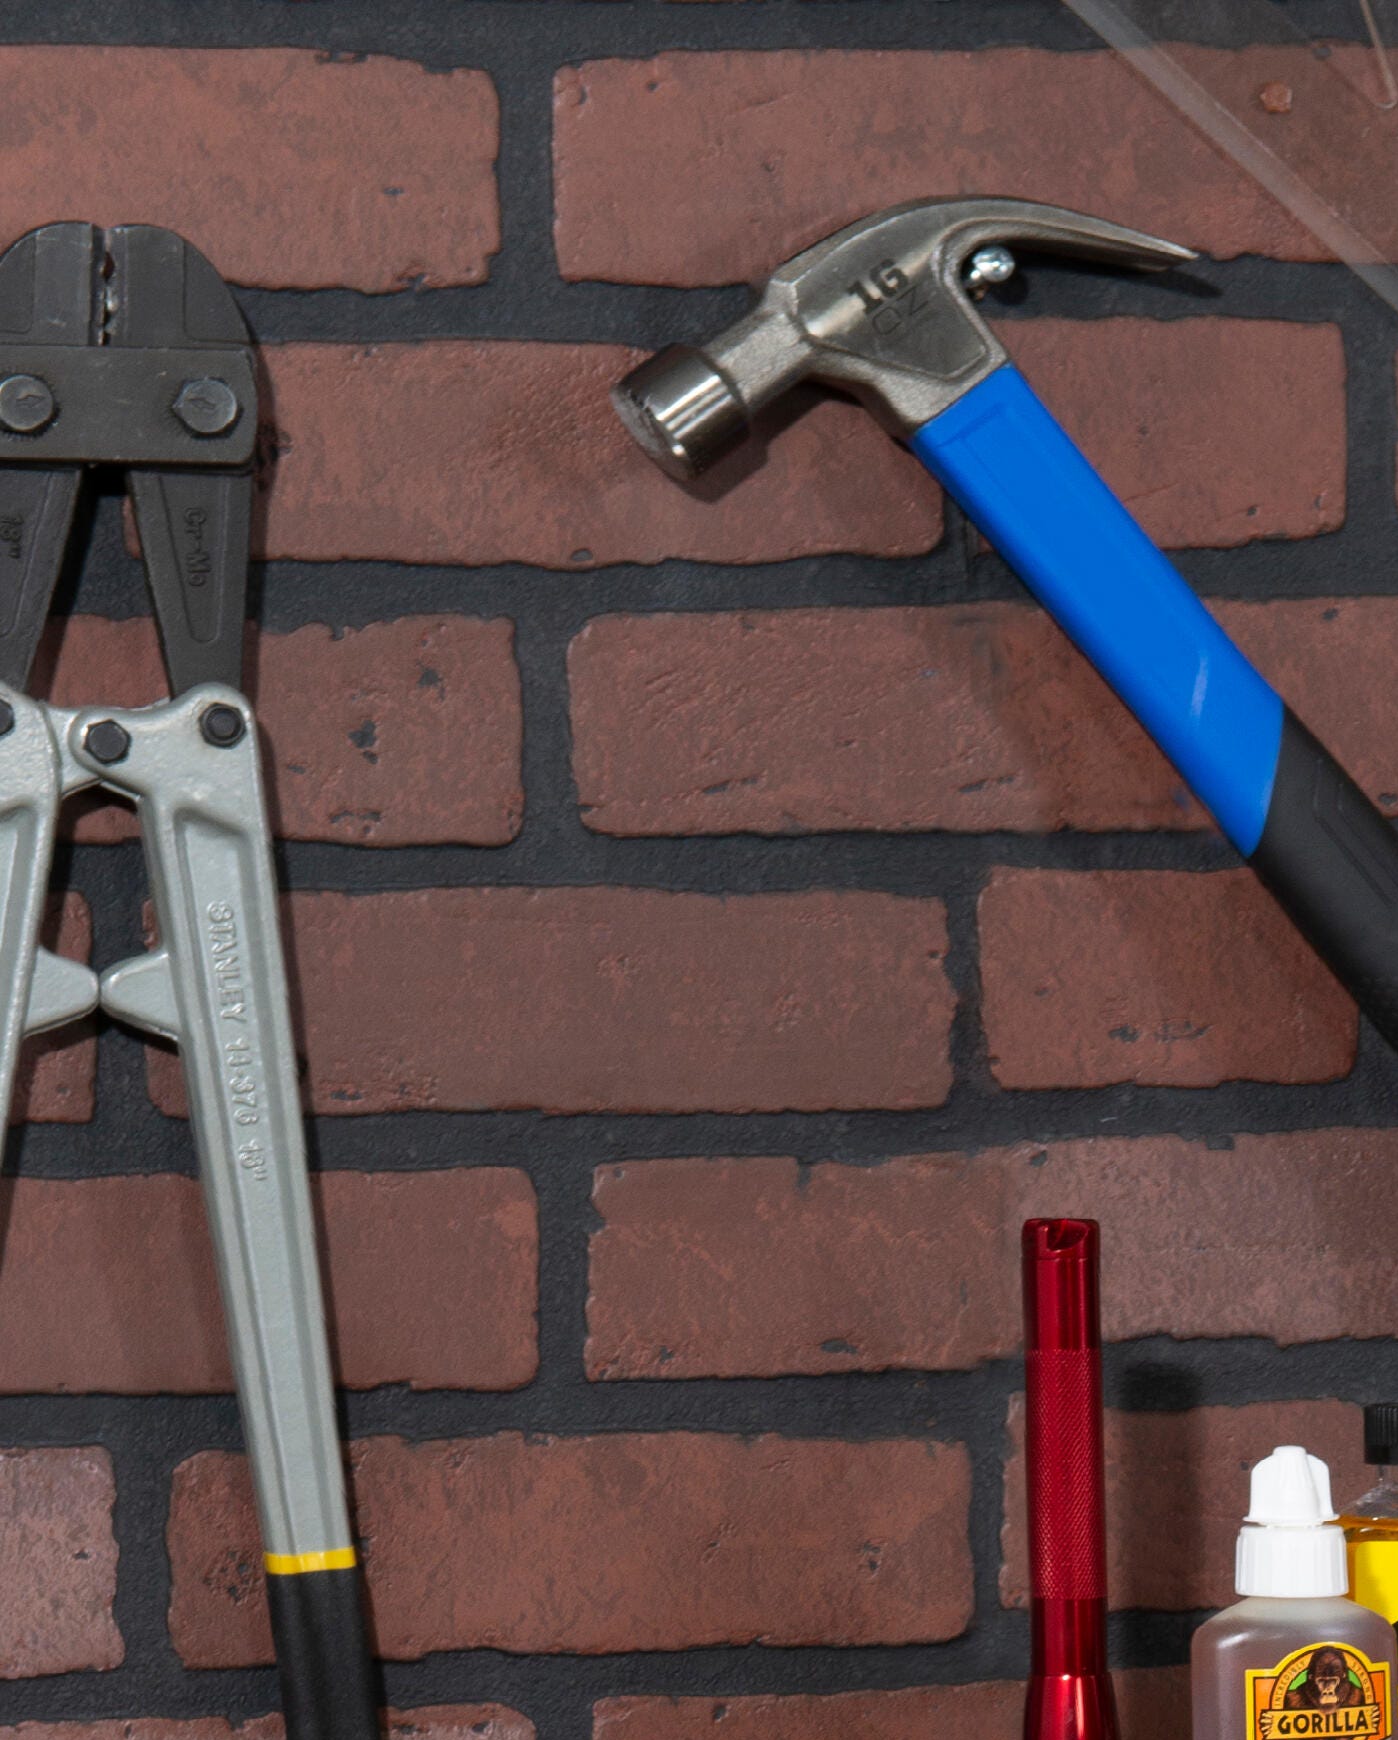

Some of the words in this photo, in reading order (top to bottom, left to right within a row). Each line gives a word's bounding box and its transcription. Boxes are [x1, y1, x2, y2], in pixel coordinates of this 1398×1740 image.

[847, 259, 908, 315] 16
[872, 286, 929, 335] OZ
[206, 900, 248, 1023] STANLEY
[1277, 1709, 1369, 1735] GORILLA
